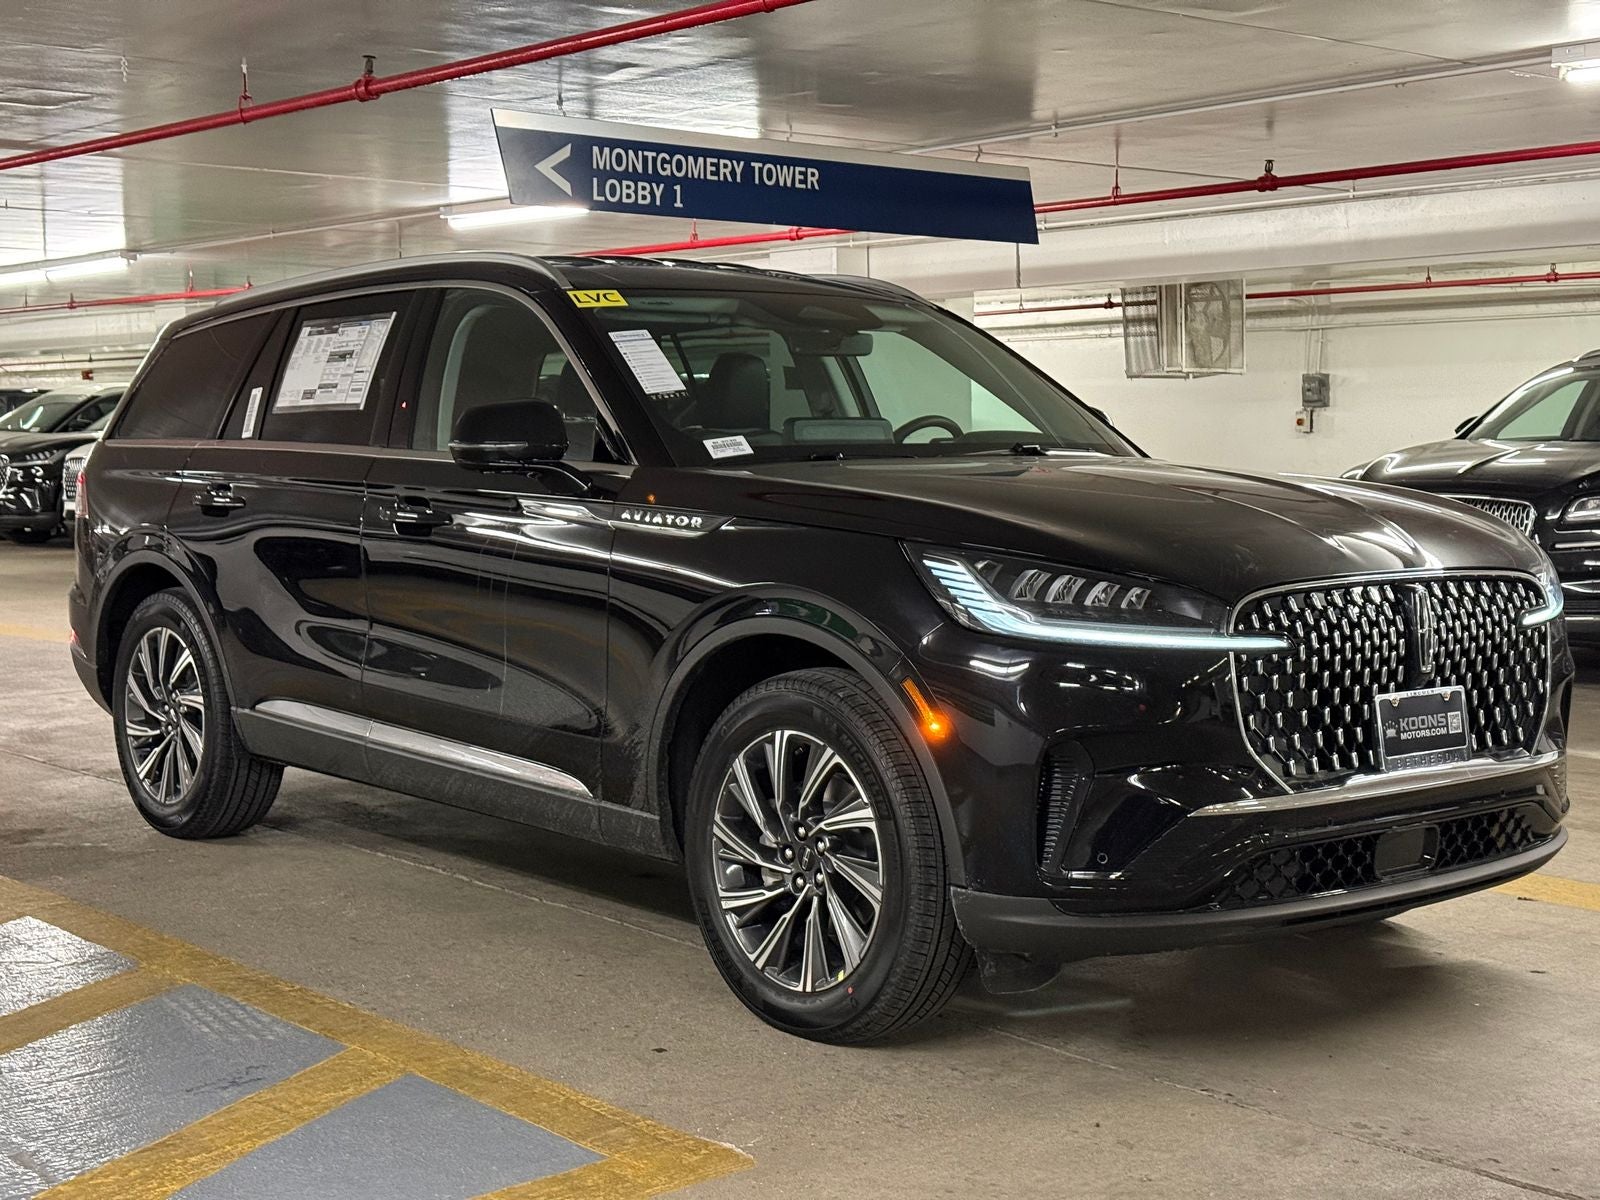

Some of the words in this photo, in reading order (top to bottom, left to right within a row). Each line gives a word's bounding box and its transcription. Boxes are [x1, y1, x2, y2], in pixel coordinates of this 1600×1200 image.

[592, 145, 744, 183] MONTGOMERY
[751, 162, 820, 190] TOWER
[592, 177, 665, 206] LOBBY
[673, 185, 684, 208] 1
[573, 293, 621, 303] LVC
[621, 509, 703, 528] AVIATOR
[1400, 713, 1447, 731] KOONS
[1400, 727, 1447, 740] MOTORS.COM
[1396, 752, 1460, 770] BETHESDA
